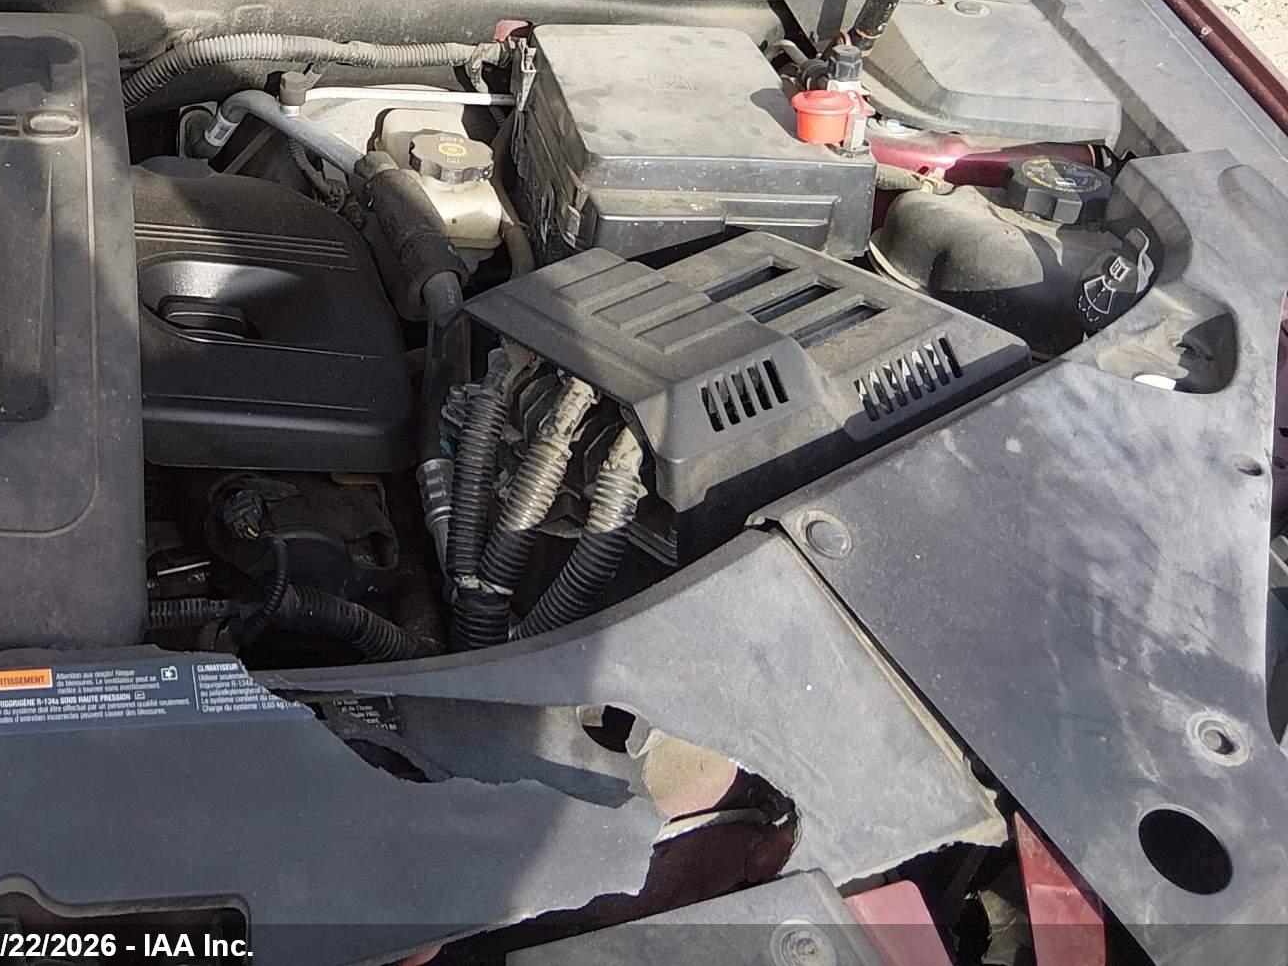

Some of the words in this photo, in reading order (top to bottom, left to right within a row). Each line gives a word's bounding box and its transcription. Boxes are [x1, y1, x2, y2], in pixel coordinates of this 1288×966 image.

[197, 663, 238, 672] CLIMATISEUR
[60, 696, 77, 704] SOUS
[78, 695, 98, 703] HAUTE
[100, 692, 131, 702] PRESSION
